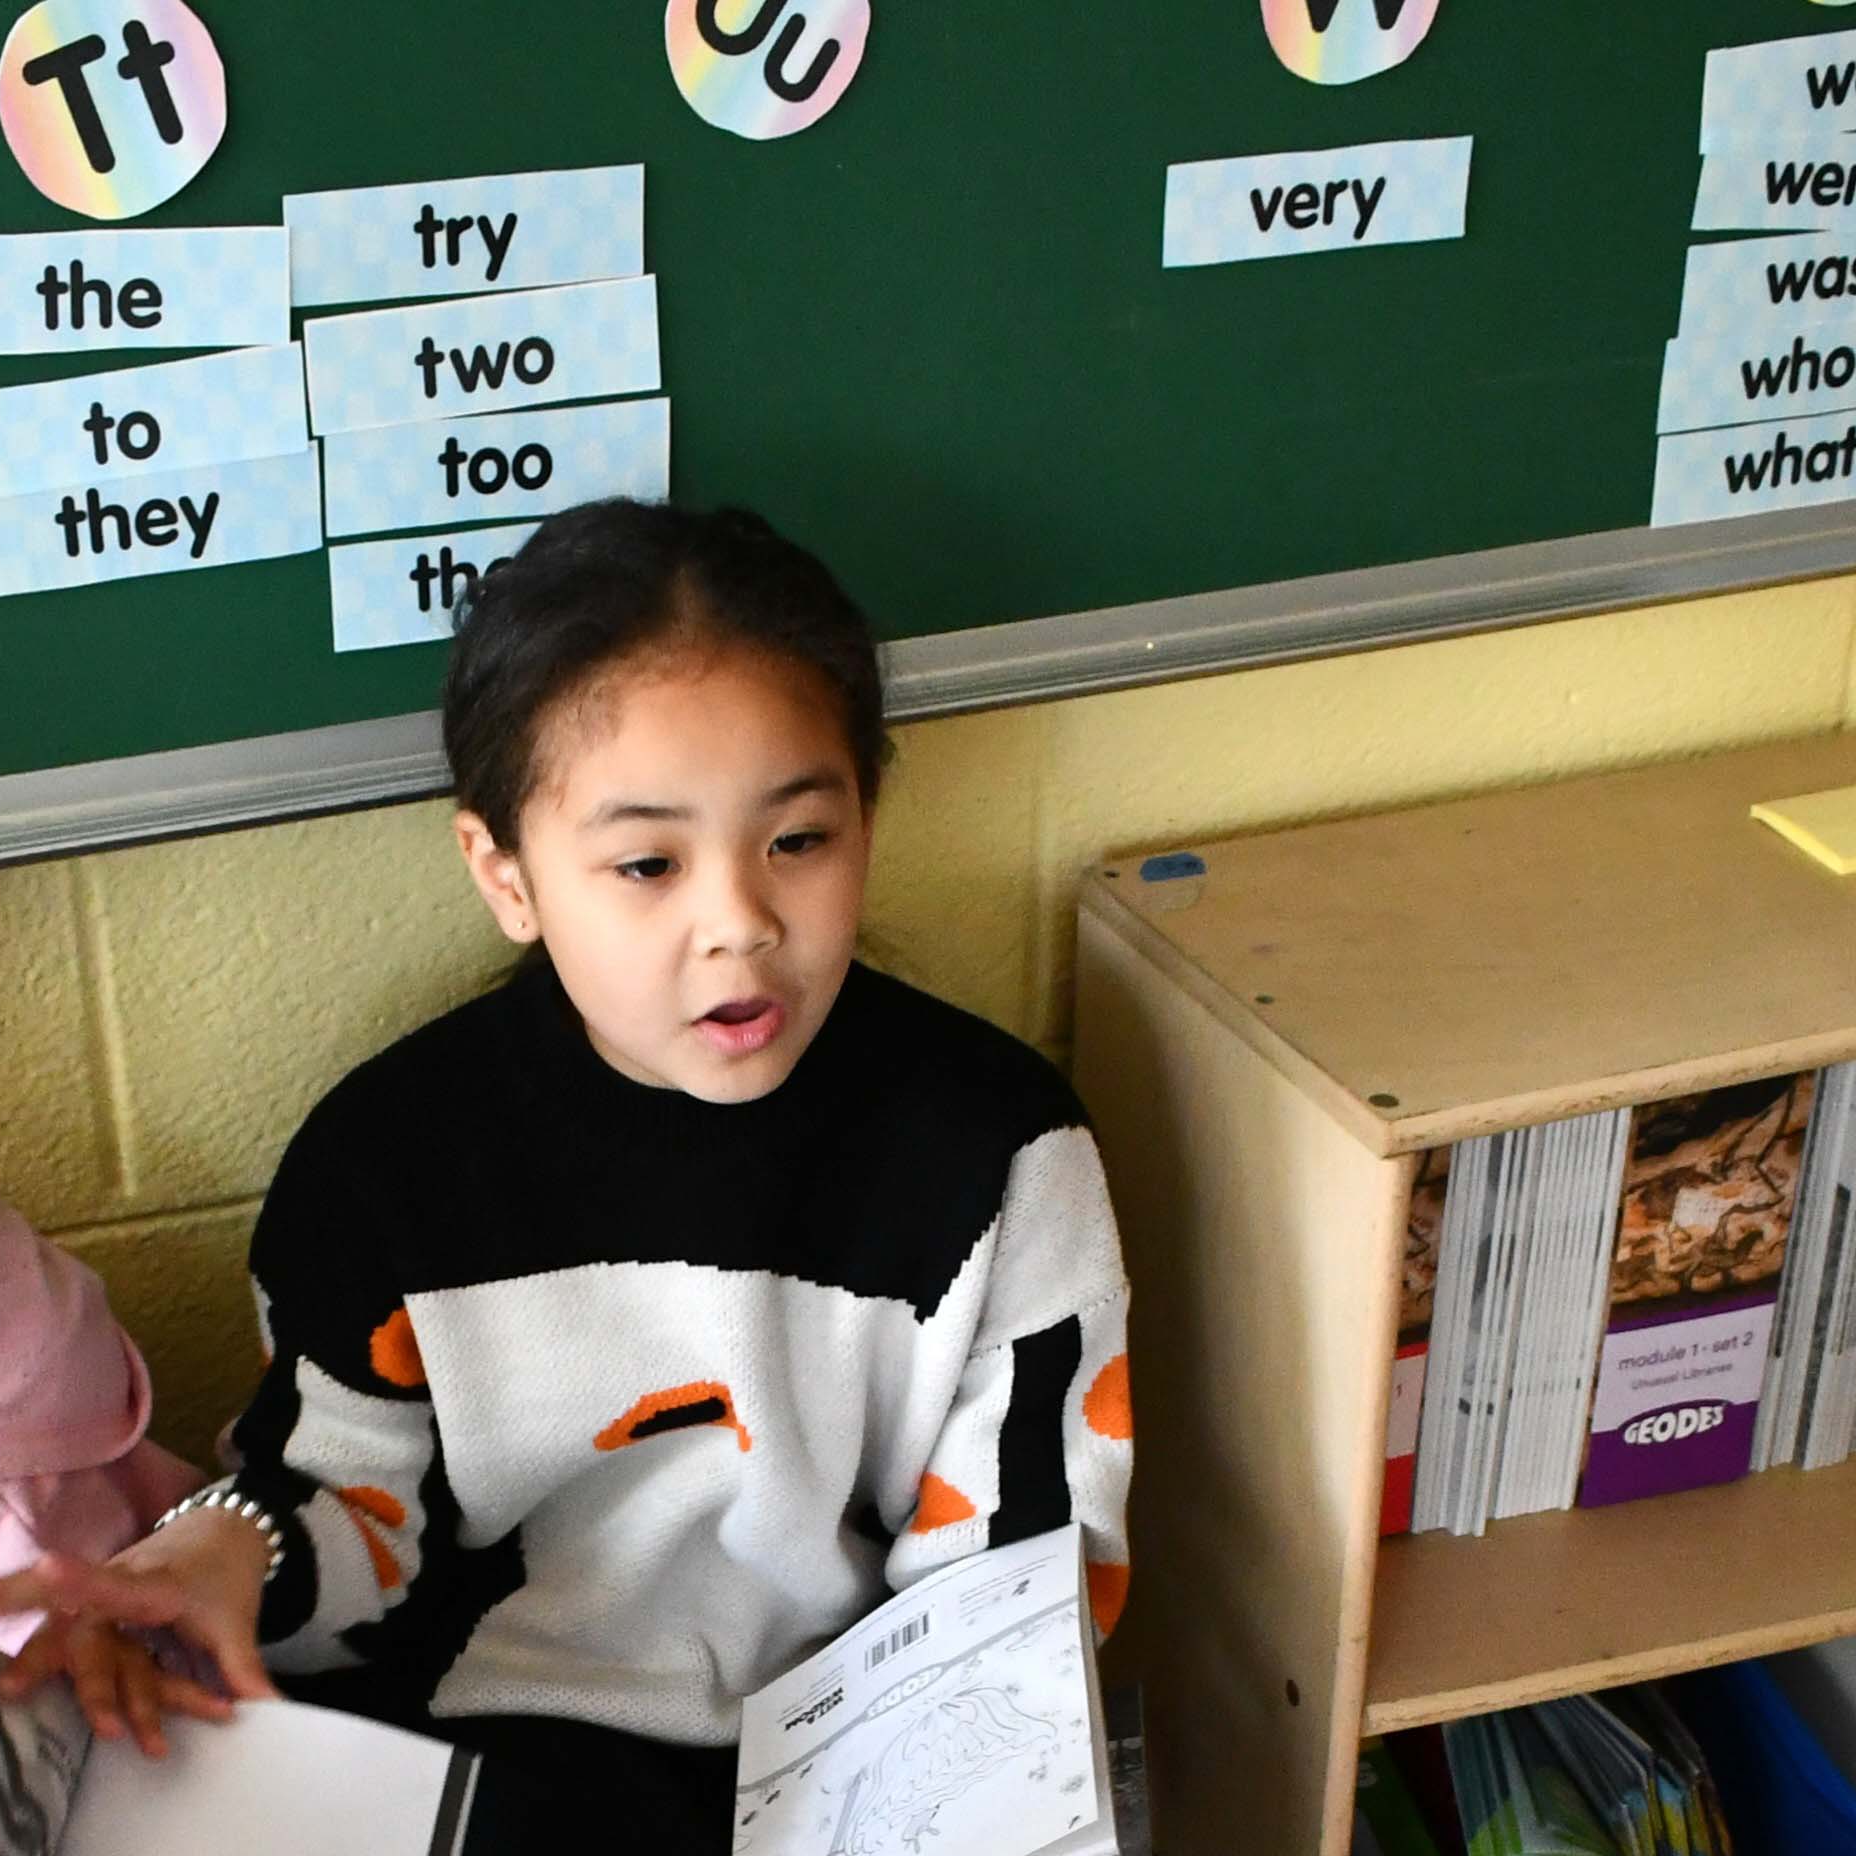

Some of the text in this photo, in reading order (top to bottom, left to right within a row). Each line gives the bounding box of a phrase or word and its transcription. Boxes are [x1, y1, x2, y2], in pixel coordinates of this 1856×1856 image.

[22, 19, 184, 174] Tt
[1251, 177, 1386, 240] very
[414, 205, 517, 281] try
[36, 260, 162, 330] the
[415, 337, 554, 398] two
[1742, 336, 1856, 399] who
[83, 402, 160, 464] to
[438, 437, 552, 497] too
[55, 488, 219, 558] they
[410, 546, 516, 612] th
[1618, 1345, 1687, 1370] module
[1692, 1343, 1699, 1357] 1
[1712, 1336, 1739, 1353] set
[1742, 1330, 1755, 1347] 2
[1623, 1402, 1727, 1445] GEODES
